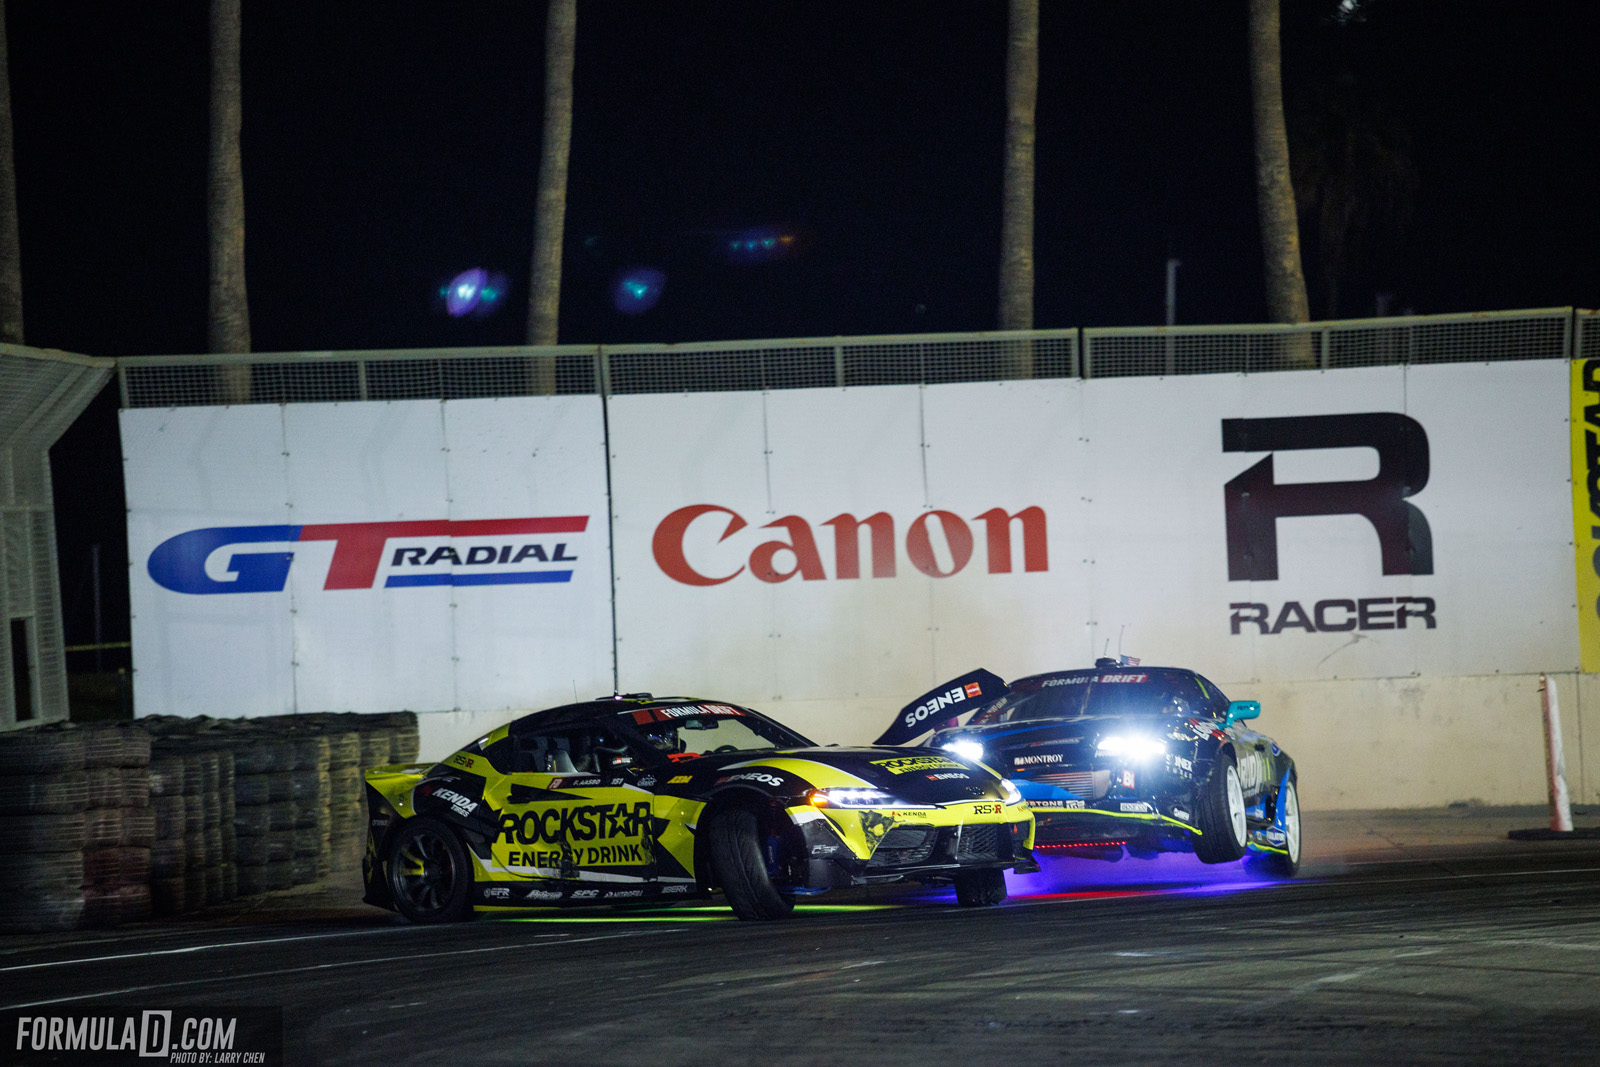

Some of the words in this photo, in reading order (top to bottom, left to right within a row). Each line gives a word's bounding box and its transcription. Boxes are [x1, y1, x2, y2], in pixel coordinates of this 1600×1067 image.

[1221, 412, 1434, 581] R
[147, 516, 590, 594] GT
[391, 543, 578, 567] RADIAL
[652, 503, 1049, 587] Canon
[1229, 596, 1437, 635] RACER
[1101, 675, 1146, 684] DRIFT
[660, 705, 711, 719] FORMULA
[905, 686, 967, 728] ENEOS
[1023, 754, 1063, 765] MONTROY
[726, 772, 784, 787] ENEOS
[432, 787, 478, 813] KENDA
[491, 802, 653, 845] ROCKSTAR
[508, 848, 584, 868] ENERY
[587, 844, 643, 864] DRINK
